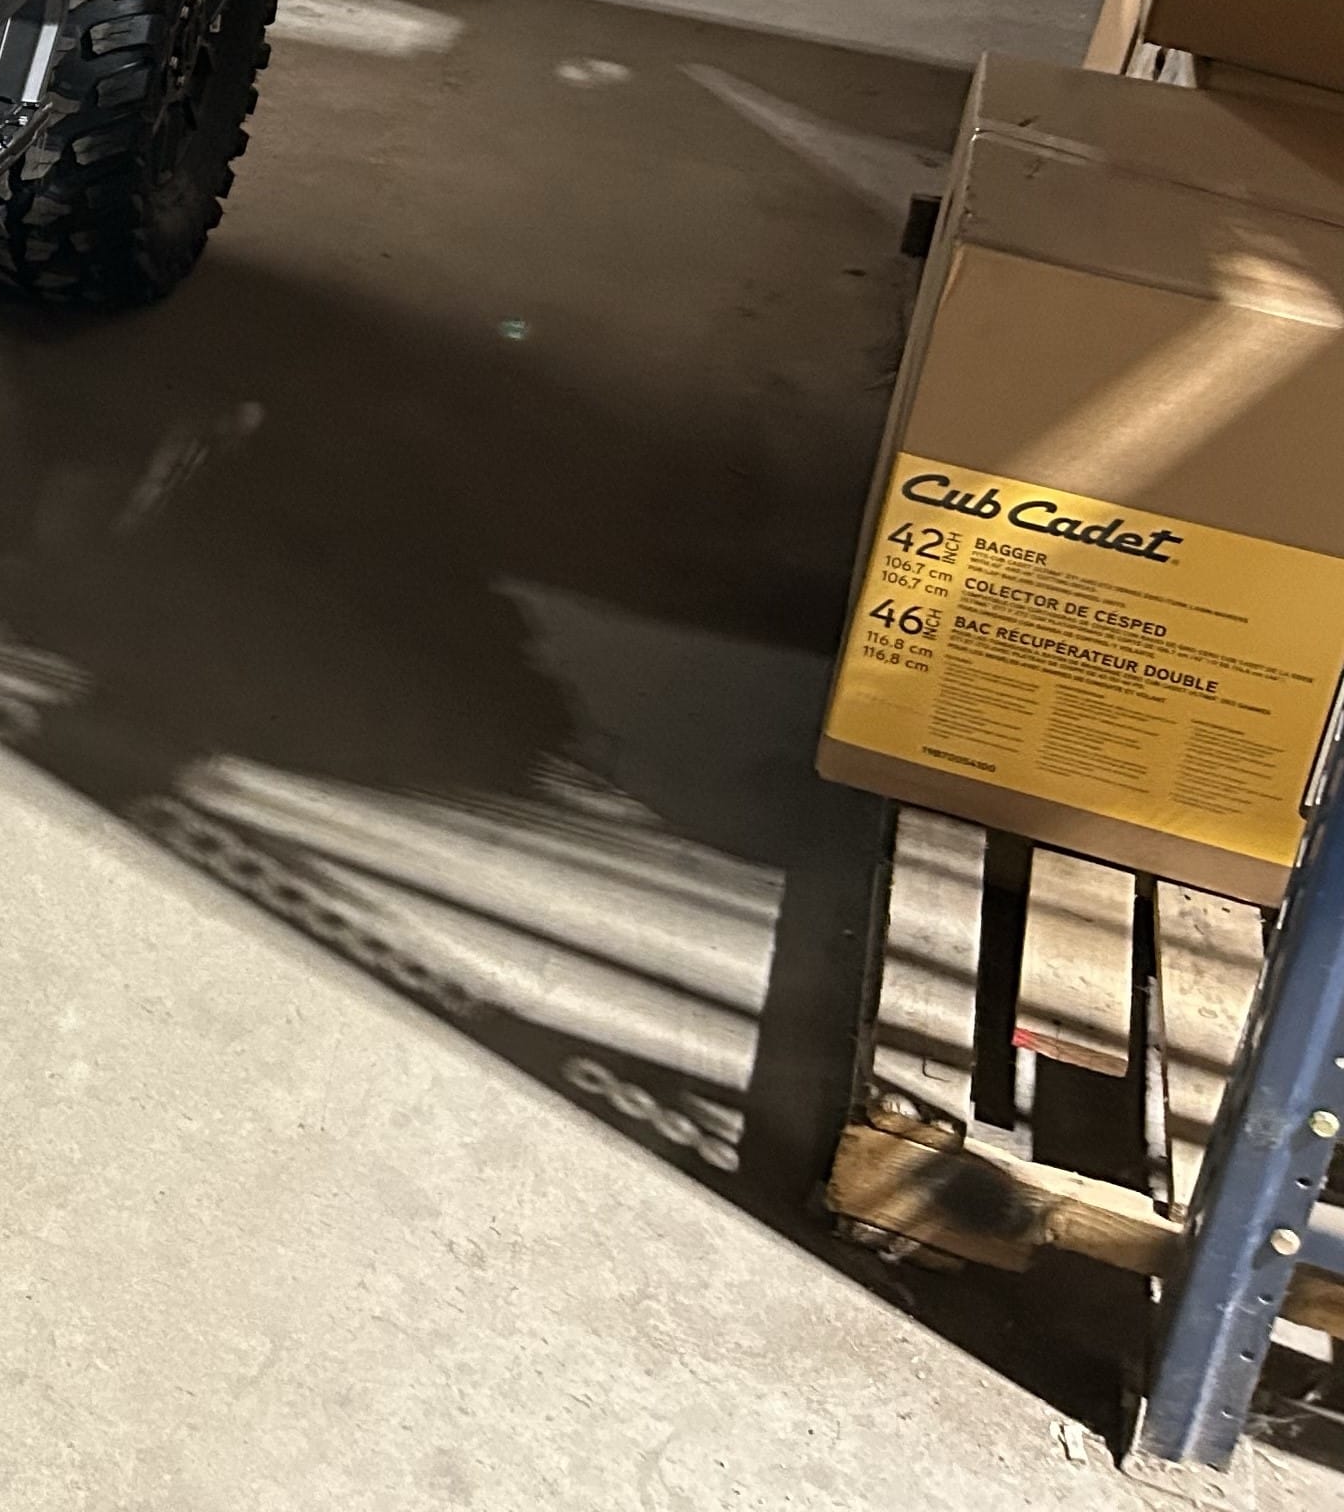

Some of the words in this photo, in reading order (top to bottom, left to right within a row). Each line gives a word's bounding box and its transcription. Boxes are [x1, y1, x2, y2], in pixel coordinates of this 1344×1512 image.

[901, 473, 1001, 519] Cub
[1007, 500, 1184, 563] Cadet
[887, 522, 945, 561] 42
[941, 531, 963, 565] INCH
[974, 537, 1048, 566] BAGGER
[885, 554, 926, 575] 106.7
[928, 568, 953, 582] cm
[924, 584, 949, 598] cm
[964, 577, 1060, 611] COLECTOR
[1065, 601, 1089, 619] DE
[1094, 607, 1167, 638] CÉSPED
[868, 598, 924, 636] 46
[921, 607, 945, 641] INCH
[862, 645, 900, 666] 116,8
[905, 659, 930, 673] cm
[866, 630, 905, 650] 116.8
[908, 644, 934, 658] cm
[954, 615, 991, 636] BAC
[996, 624, 1138, 674] RÉCUPÉRATEUR
[1143, 664, 1219, 694] DOUBLE
